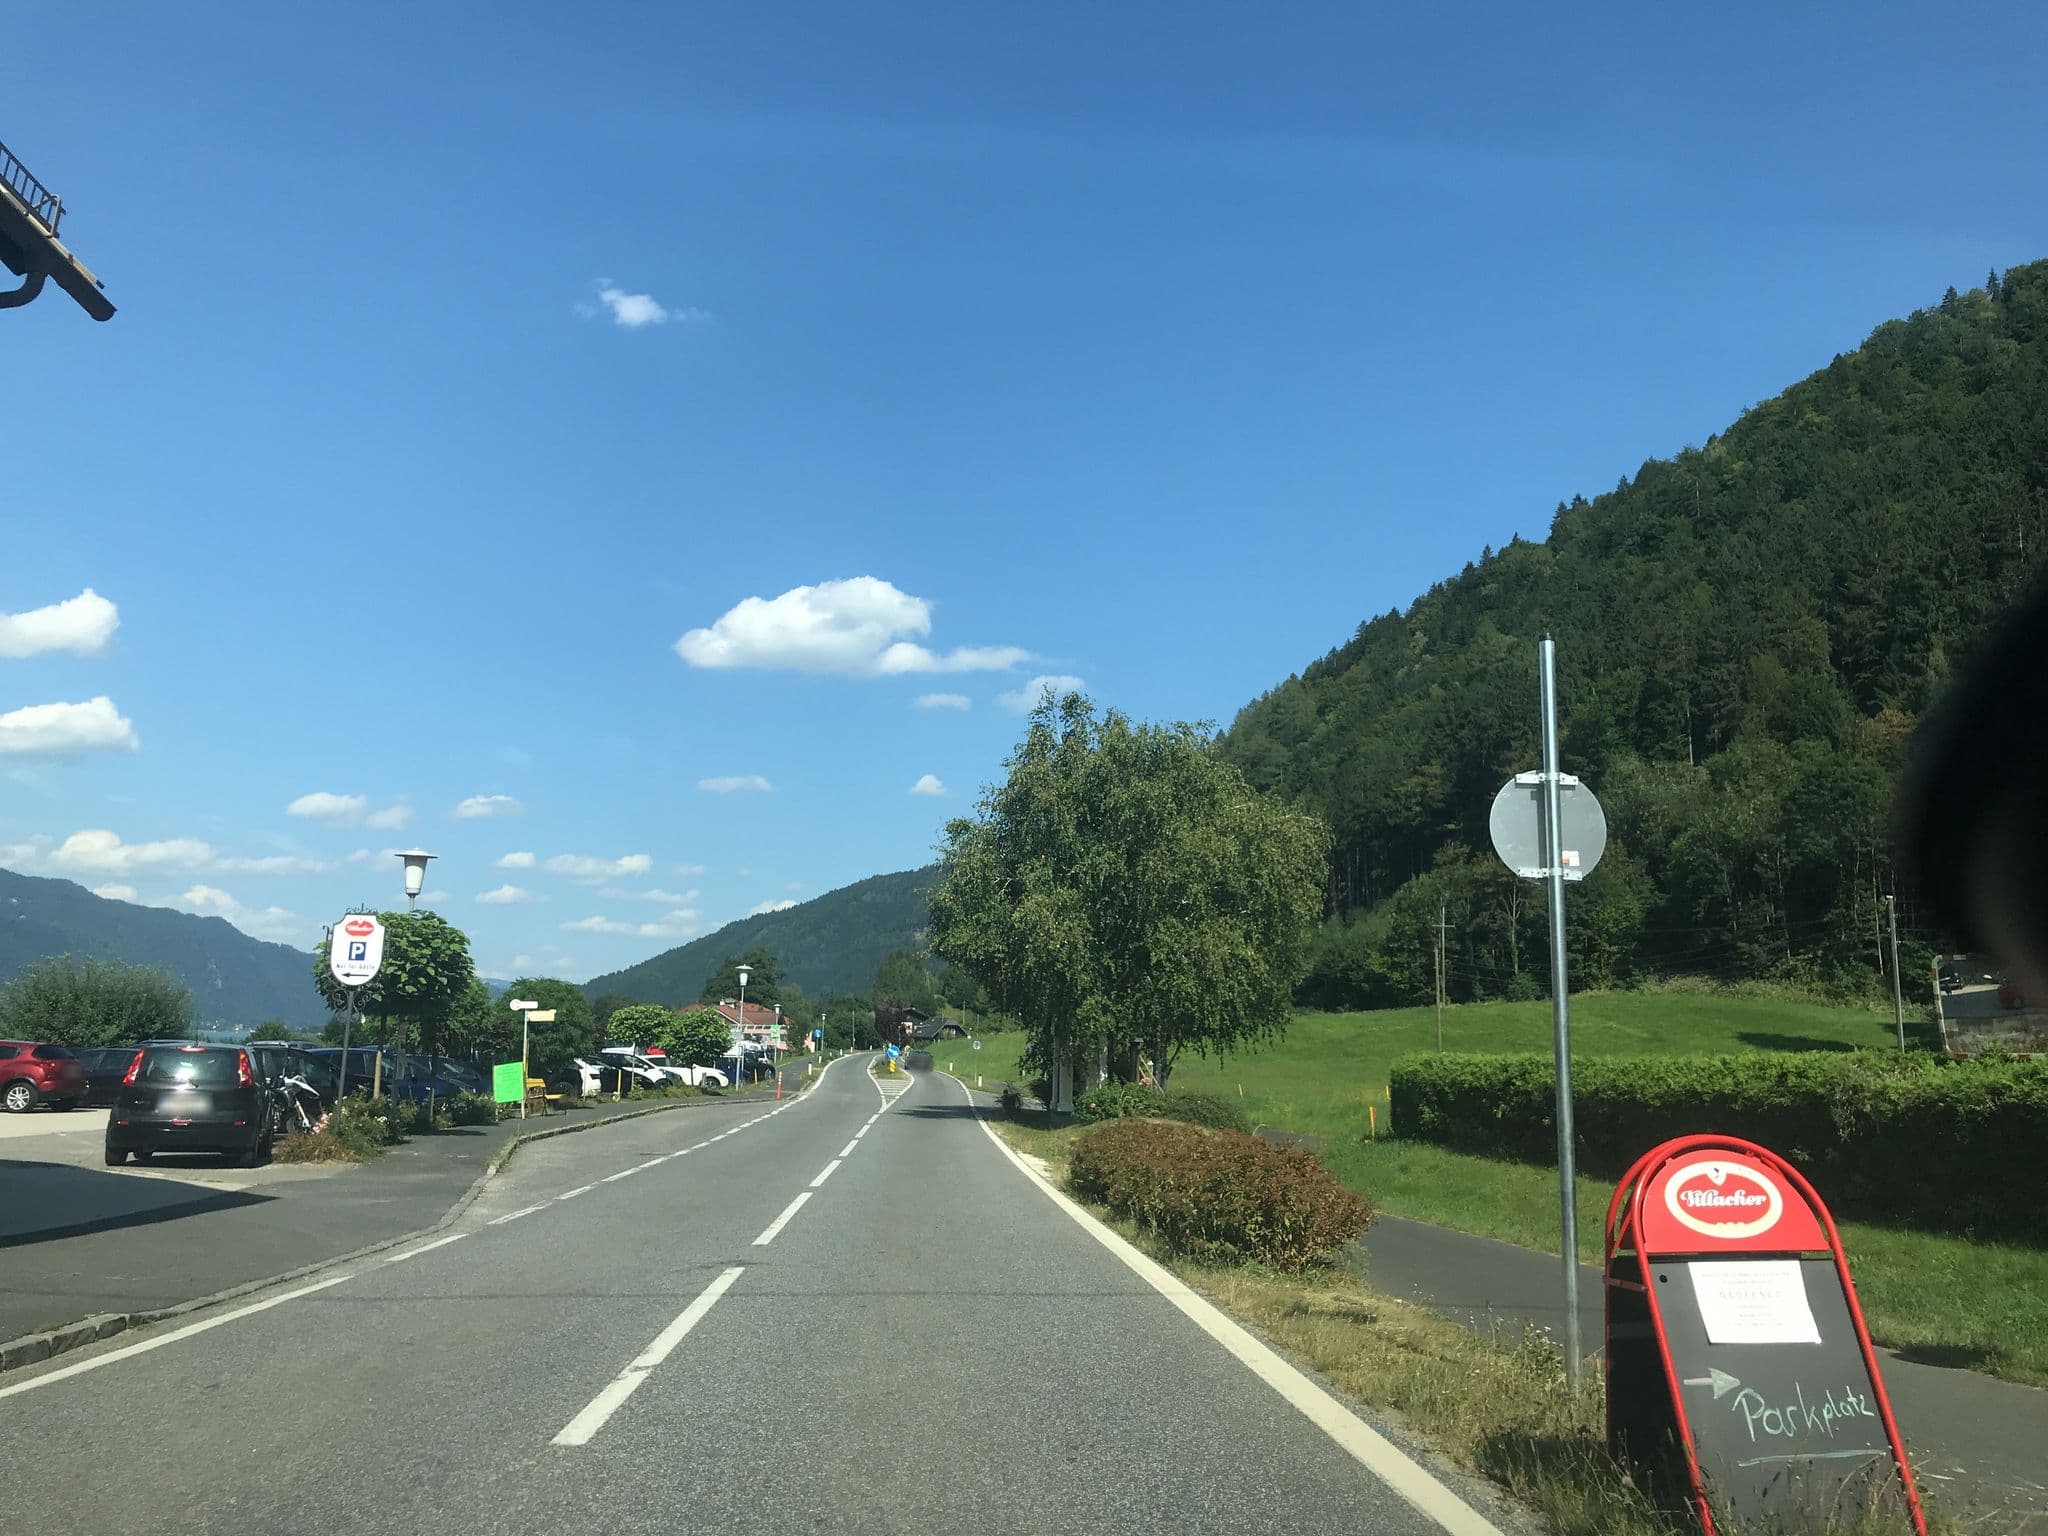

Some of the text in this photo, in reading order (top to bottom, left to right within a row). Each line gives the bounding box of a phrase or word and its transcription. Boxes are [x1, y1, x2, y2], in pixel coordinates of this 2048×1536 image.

[350, 942, 365, 960] P
[1679, 1188, 1767, 1208] Villacher
[1732, 1382, 1875, 1442] Parkplatz
